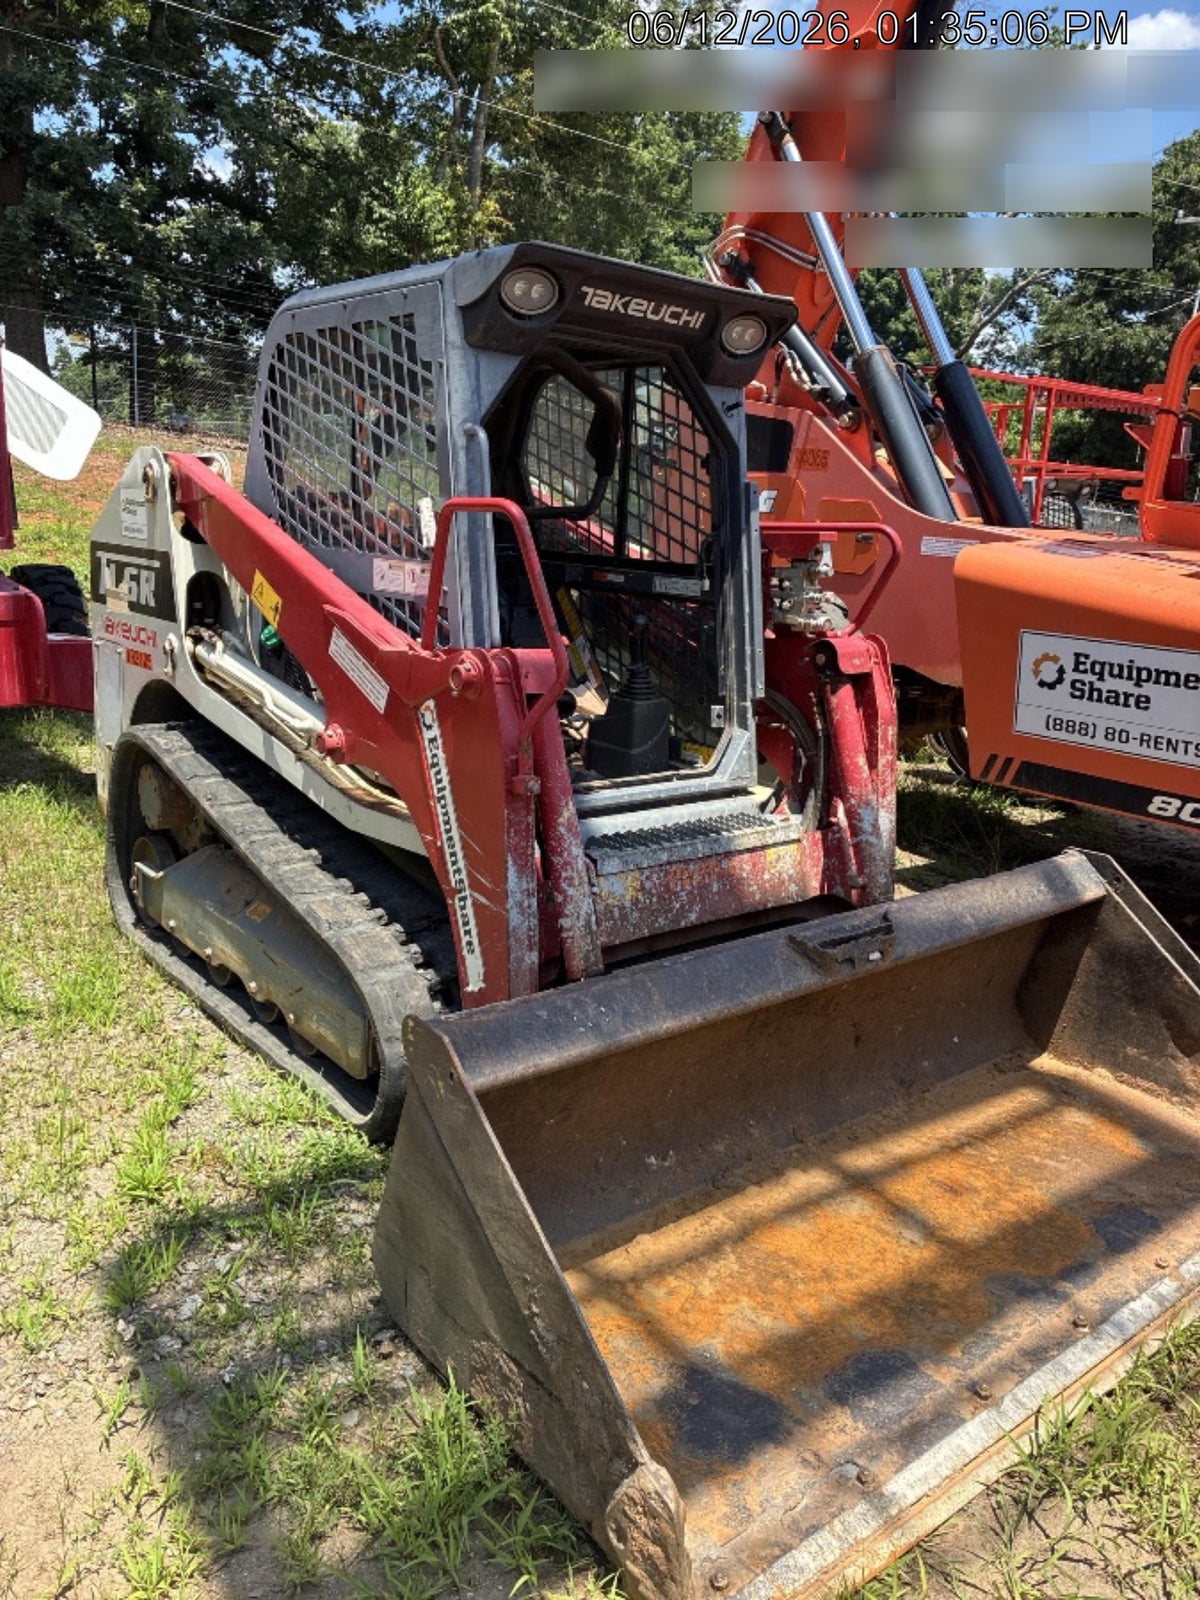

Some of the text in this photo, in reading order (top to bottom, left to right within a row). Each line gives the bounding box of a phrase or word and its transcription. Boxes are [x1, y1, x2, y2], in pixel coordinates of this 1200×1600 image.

[1072, 652, 1200, 691] Equipme
[1069, 678, 1151, 711] Share
[1045, 714, 1097, 740] (888)
